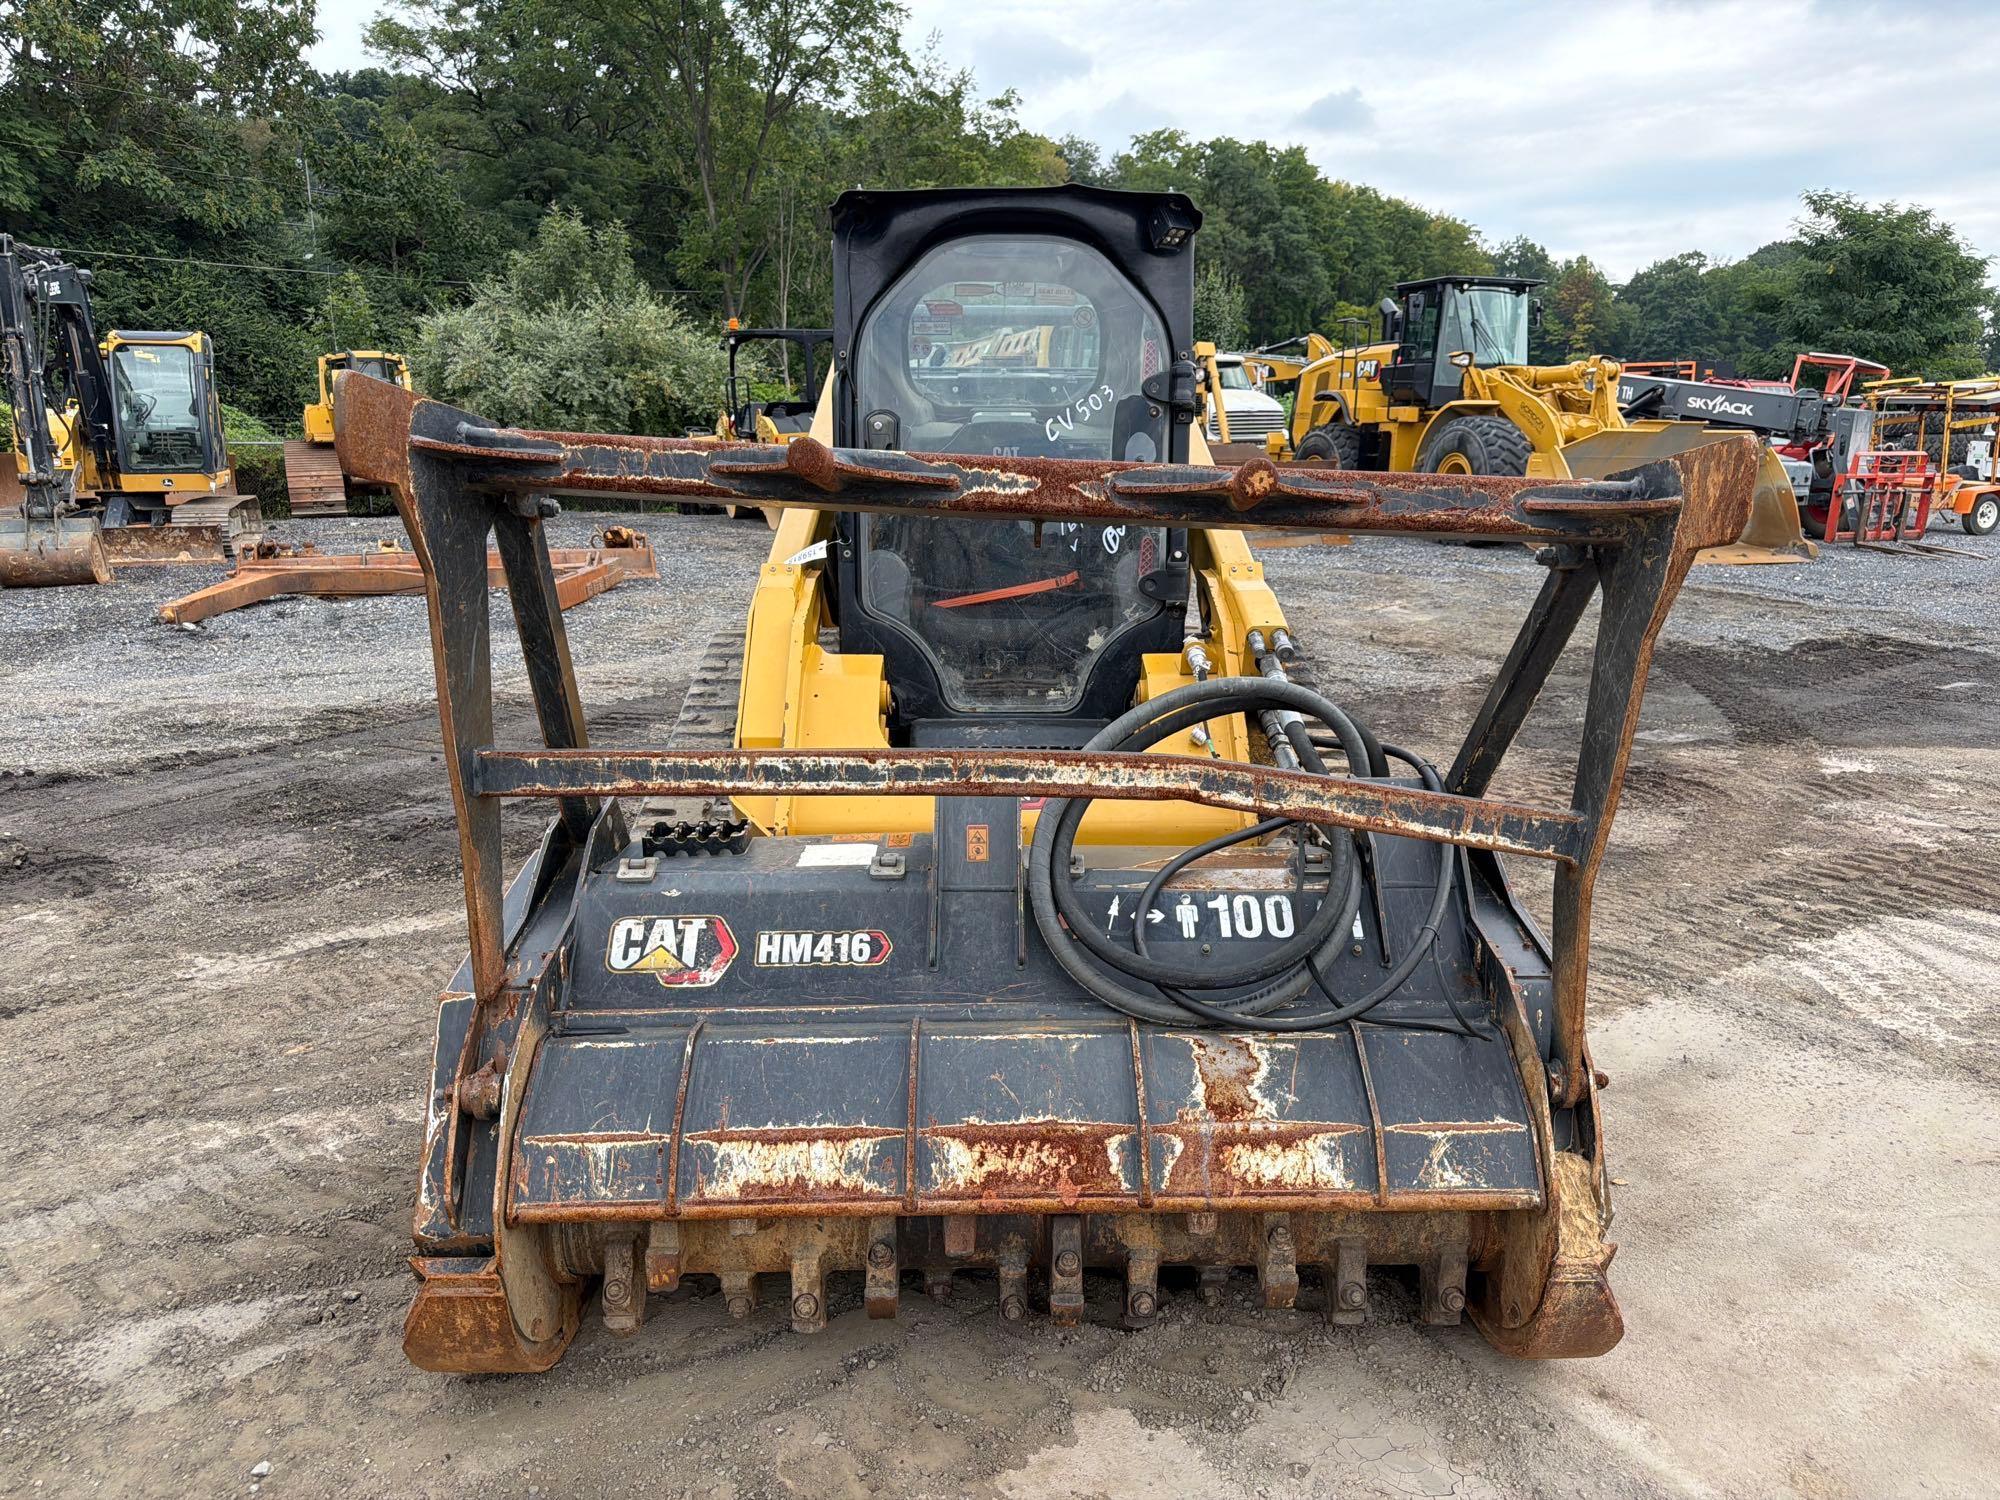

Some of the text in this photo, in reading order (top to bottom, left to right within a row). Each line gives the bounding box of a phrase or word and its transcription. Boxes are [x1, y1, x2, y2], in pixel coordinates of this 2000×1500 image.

[1357, 360, 1377, 377] CAT
[1076, 385, 1113, 421] 503
[1622, 385, 1634, 401] TH
[1687, 395, 1754, 416] SKYJACK
[993, 446, 1020, 457] CAT
[1207, 894, 1295, 938] 100
[609, 918, 707, 970] CAT
[758, 932, 873, 963] HM416
